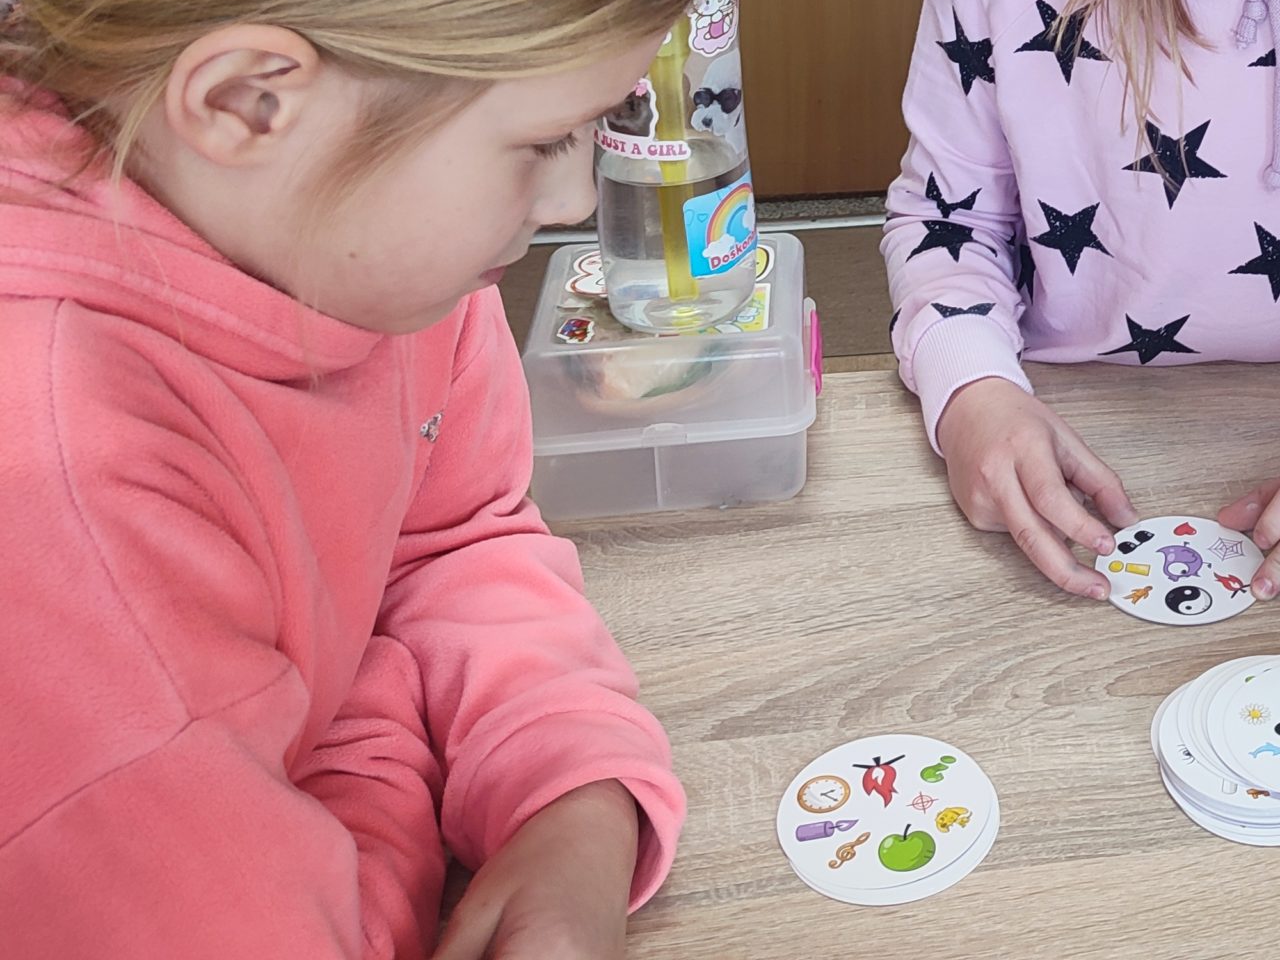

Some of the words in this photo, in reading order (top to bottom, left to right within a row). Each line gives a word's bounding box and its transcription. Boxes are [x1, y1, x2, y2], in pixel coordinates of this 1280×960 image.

[601, 131, 626, 153] JUST
[631, 143, 642, 155] A
[647, 144, 687, 156] GIRL
